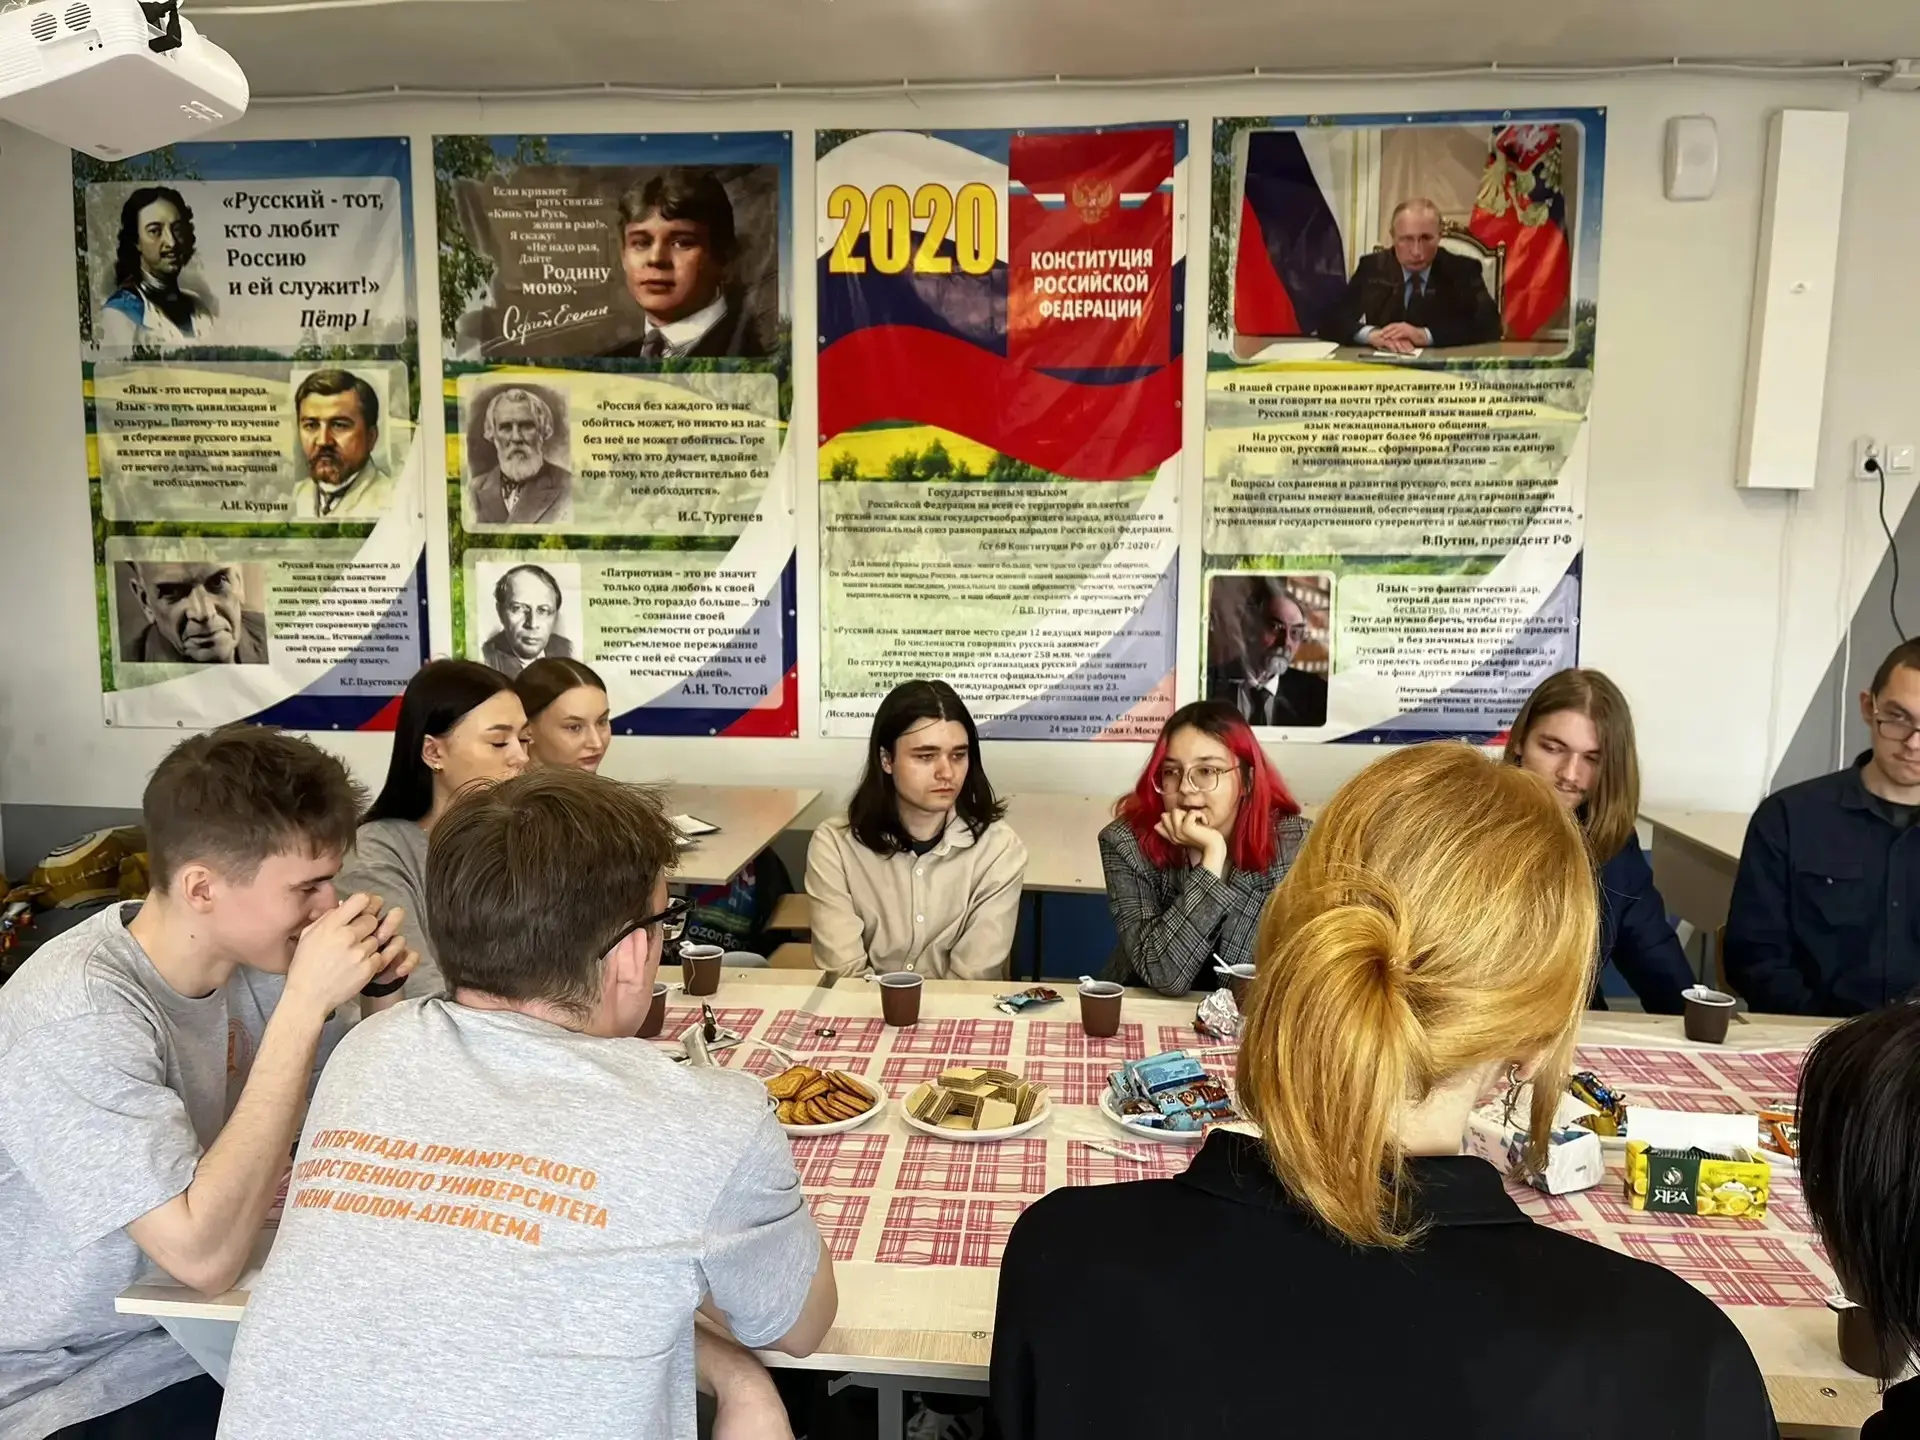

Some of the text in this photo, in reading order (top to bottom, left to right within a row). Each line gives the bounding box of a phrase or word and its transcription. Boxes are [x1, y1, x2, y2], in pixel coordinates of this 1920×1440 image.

[493, 187, 568, 198] Если крикнет
[223, 190, 384, 212] «Русский тот,
[225, 220, 339, 240] кто любит
[827, 182, 998, 274] 2020
[227, 249, 306, 267] Россию
[519, 254, 552, 265] Дайте
[1031, 248, 1153, 273] КОНСТИТУЦИЯ
[543, 264, 611, 283] Родину
[229, 275, 379, 300] и ей служит!»
[1034, 270, 1148, 295] РОССИЙСКОЙ
[522, 283, 577, 295] мою».
[1039, 298, 1142, 322] ФЕДЕРАЦИИ
[301, 308, 369, 331] Пётр I
[597, 400, 641, 411] «Россия
[644, 401, 662, 410] без
[665, 402, 713, 413] каждого
[582, 418, 766, 429] обойтись может, но никто из нас
[132, 433, 191, 443] сбережение
[194, 434, 237, 443] русского
[584, 435, 602, 445] без
[605, 435, 624, 445] неё
[643, 436, 678, 445] может
[681, 435, 737, 445] обойтись.
[740, 435, 765, 447] Горе
[592, 452, 757, 464] тому, кто это думает, вдвойне
[581, 469, 769, 480] горе тому, кто действительно без
[221, 500, 288, 512] А.И. Куприн
[678, 511, 763, 524] И.С. Тургенев
[601, 568, 756, 579] «Патриотизм это не значит
[604, 583, 755, 594] только одна любовь к своей
[643, 611, 725, 621] сознание своей
[601, 626, 760, 637] неотъемлемости от родины и
[630, 667, 732, 678] несчастных дней».
[357, 677, 410, 688] Паустовски
[682, 684, 768, 696] А.Н. Толстой
[420, 1144, 597, 1191] ПРИАМУРСКОГО
[435, 1175, 609, 1229] УНИВЕРСИТЕТА
[1653, 1189, 1690, 1206] ЯВА
[331, 1189, 542, 1246] ШОЛОМ-АЛЕЙХЕМА
